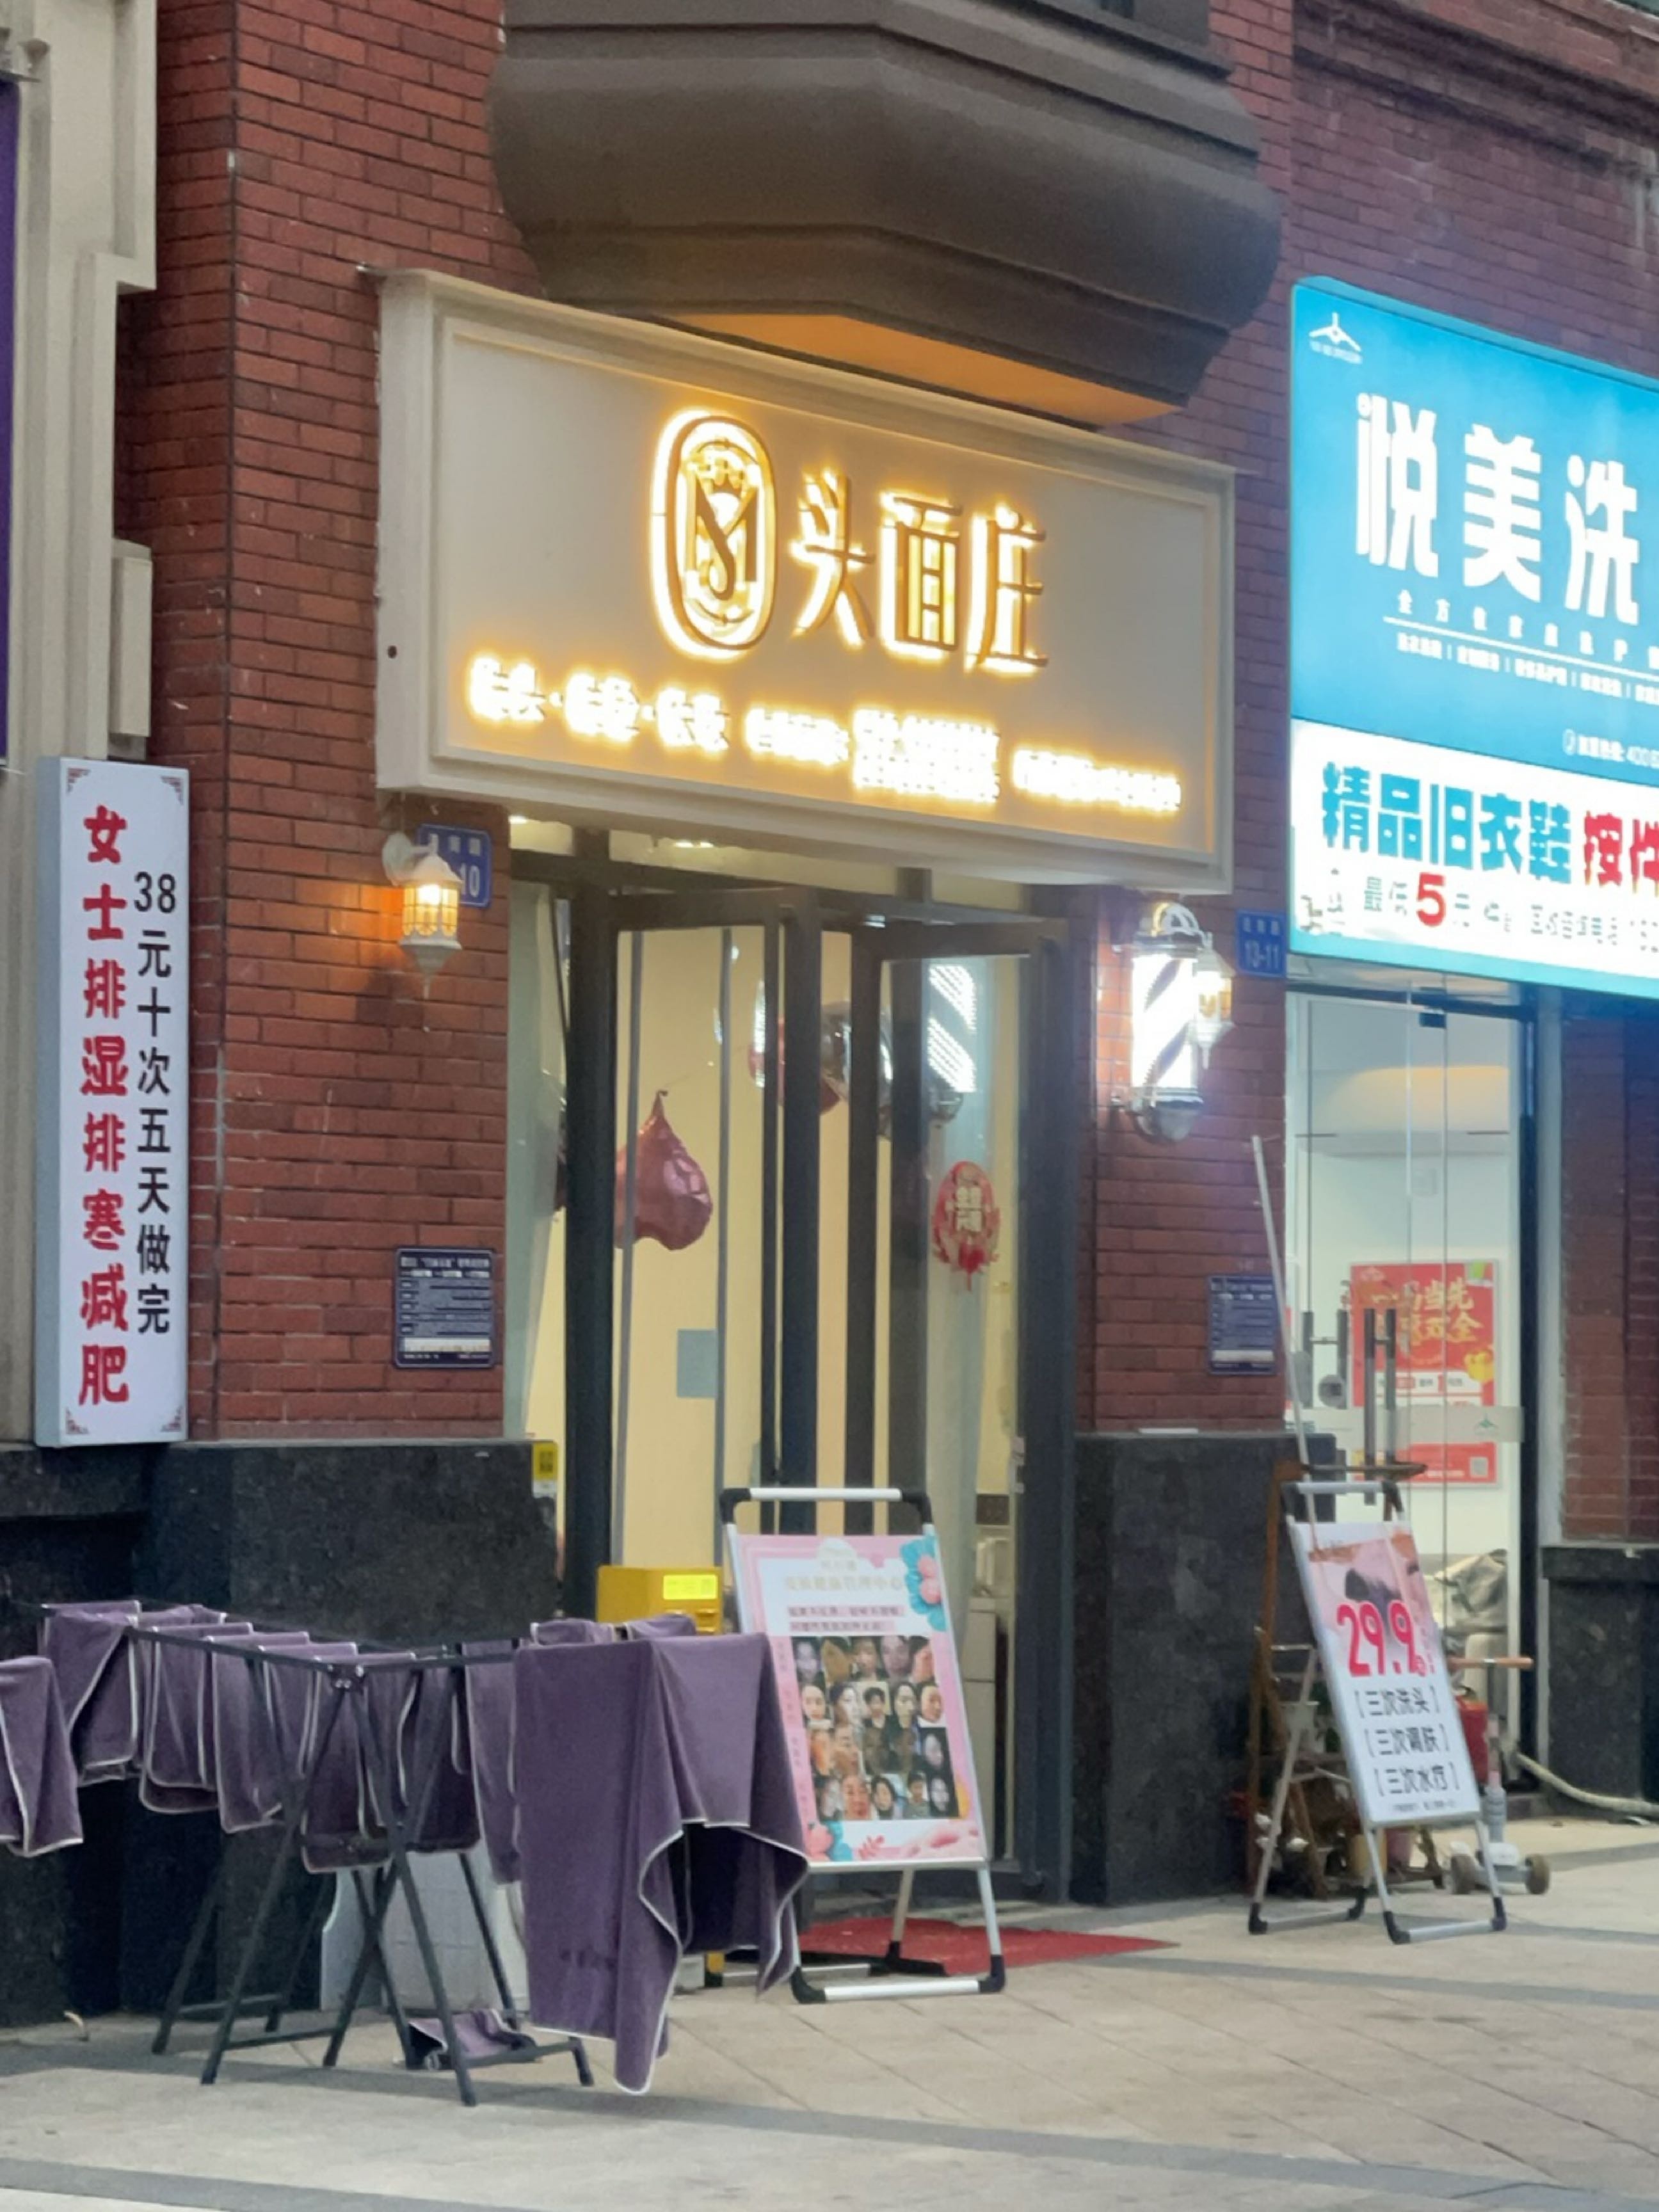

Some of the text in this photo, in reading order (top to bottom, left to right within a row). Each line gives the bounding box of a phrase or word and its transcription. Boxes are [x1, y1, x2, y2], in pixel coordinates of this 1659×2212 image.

[792, 471, 1048, 675] 头面庄
[1356, 393, 1639, 625] 悦美洗
[79, 805, 129, 1406] 女士排湿排寒减肥
[133, 872, 177, 1335] 38元十次五天做完
